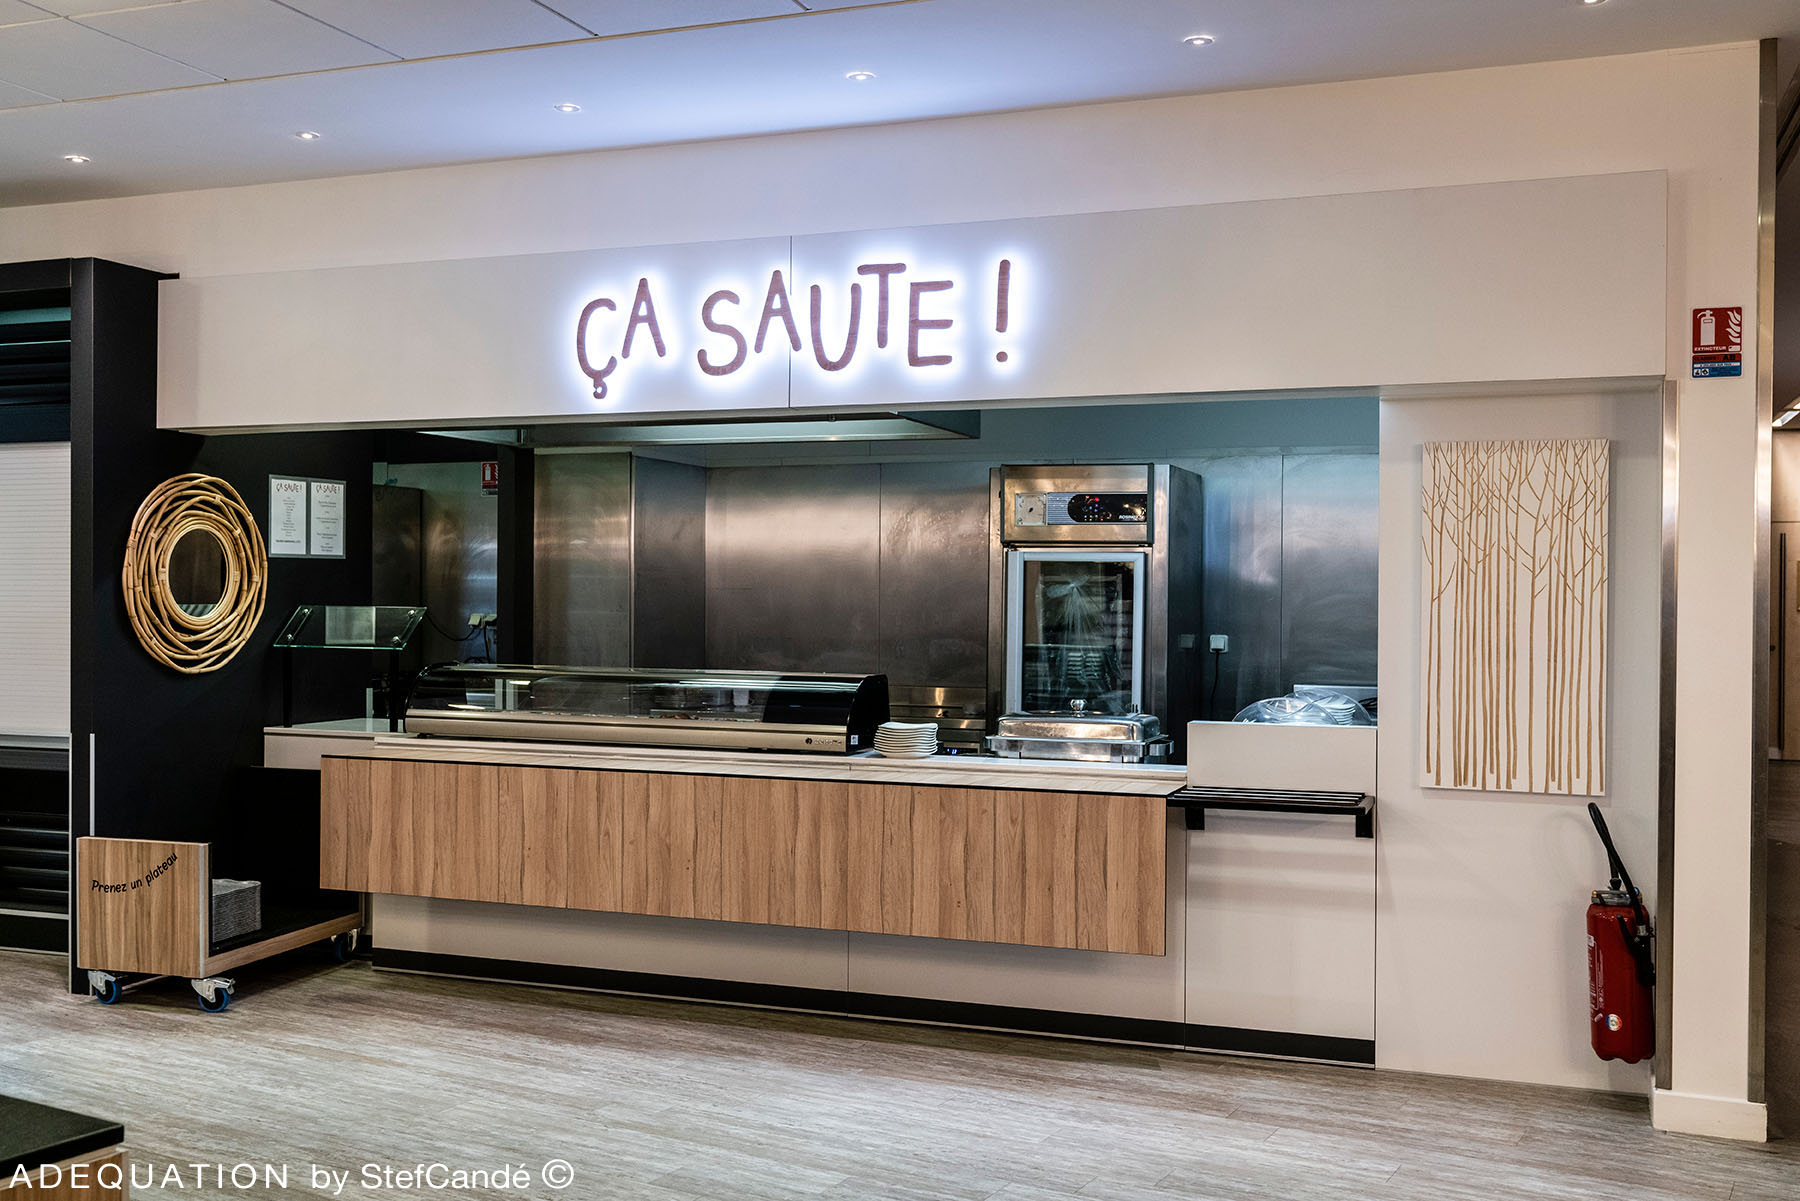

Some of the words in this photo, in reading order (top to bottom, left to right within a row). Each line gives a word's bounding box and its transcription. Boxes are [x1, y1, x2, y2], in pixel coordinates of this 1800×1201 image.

[576, 277, 666, 400] ÇA
[697, 262, 954, 377] SAUTE
[995, 259, 1011, 363] !
[283, 482, 299, 493] SAUTE
[91, 879, 127, 893] Prenez
[130, 879, 143, 890] un
[145, 852, 178, 887] plateau
